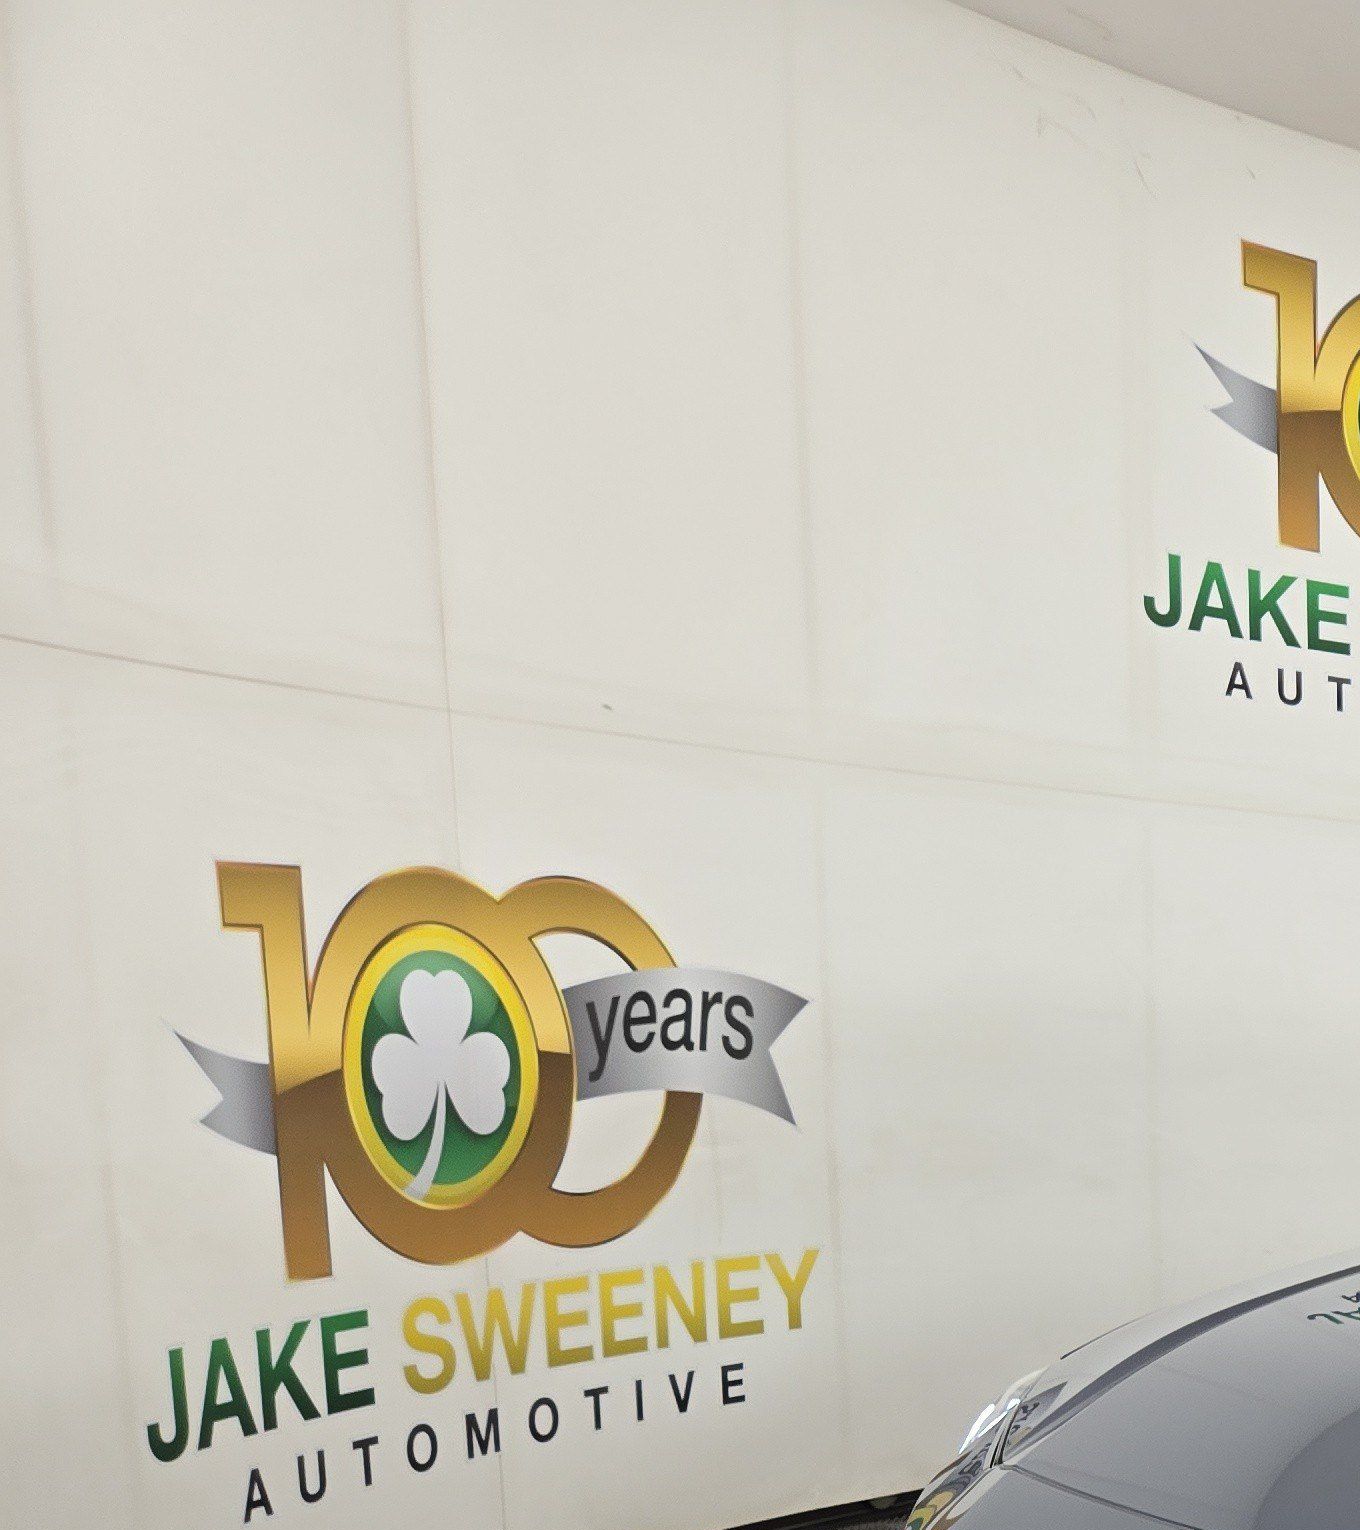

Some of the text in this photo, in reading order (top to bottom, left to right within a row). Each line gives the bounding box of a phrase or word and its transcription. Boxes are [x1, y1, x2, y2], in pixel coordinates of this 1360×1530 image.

[1144, 552, 1351, 656] JAKE
[216, 861, 754, 1282] 100 years
[146, 1250, 820, 1463] JAKE SWEENEY
[244, 1362, 745, 1523] AUTOMOTIVE
